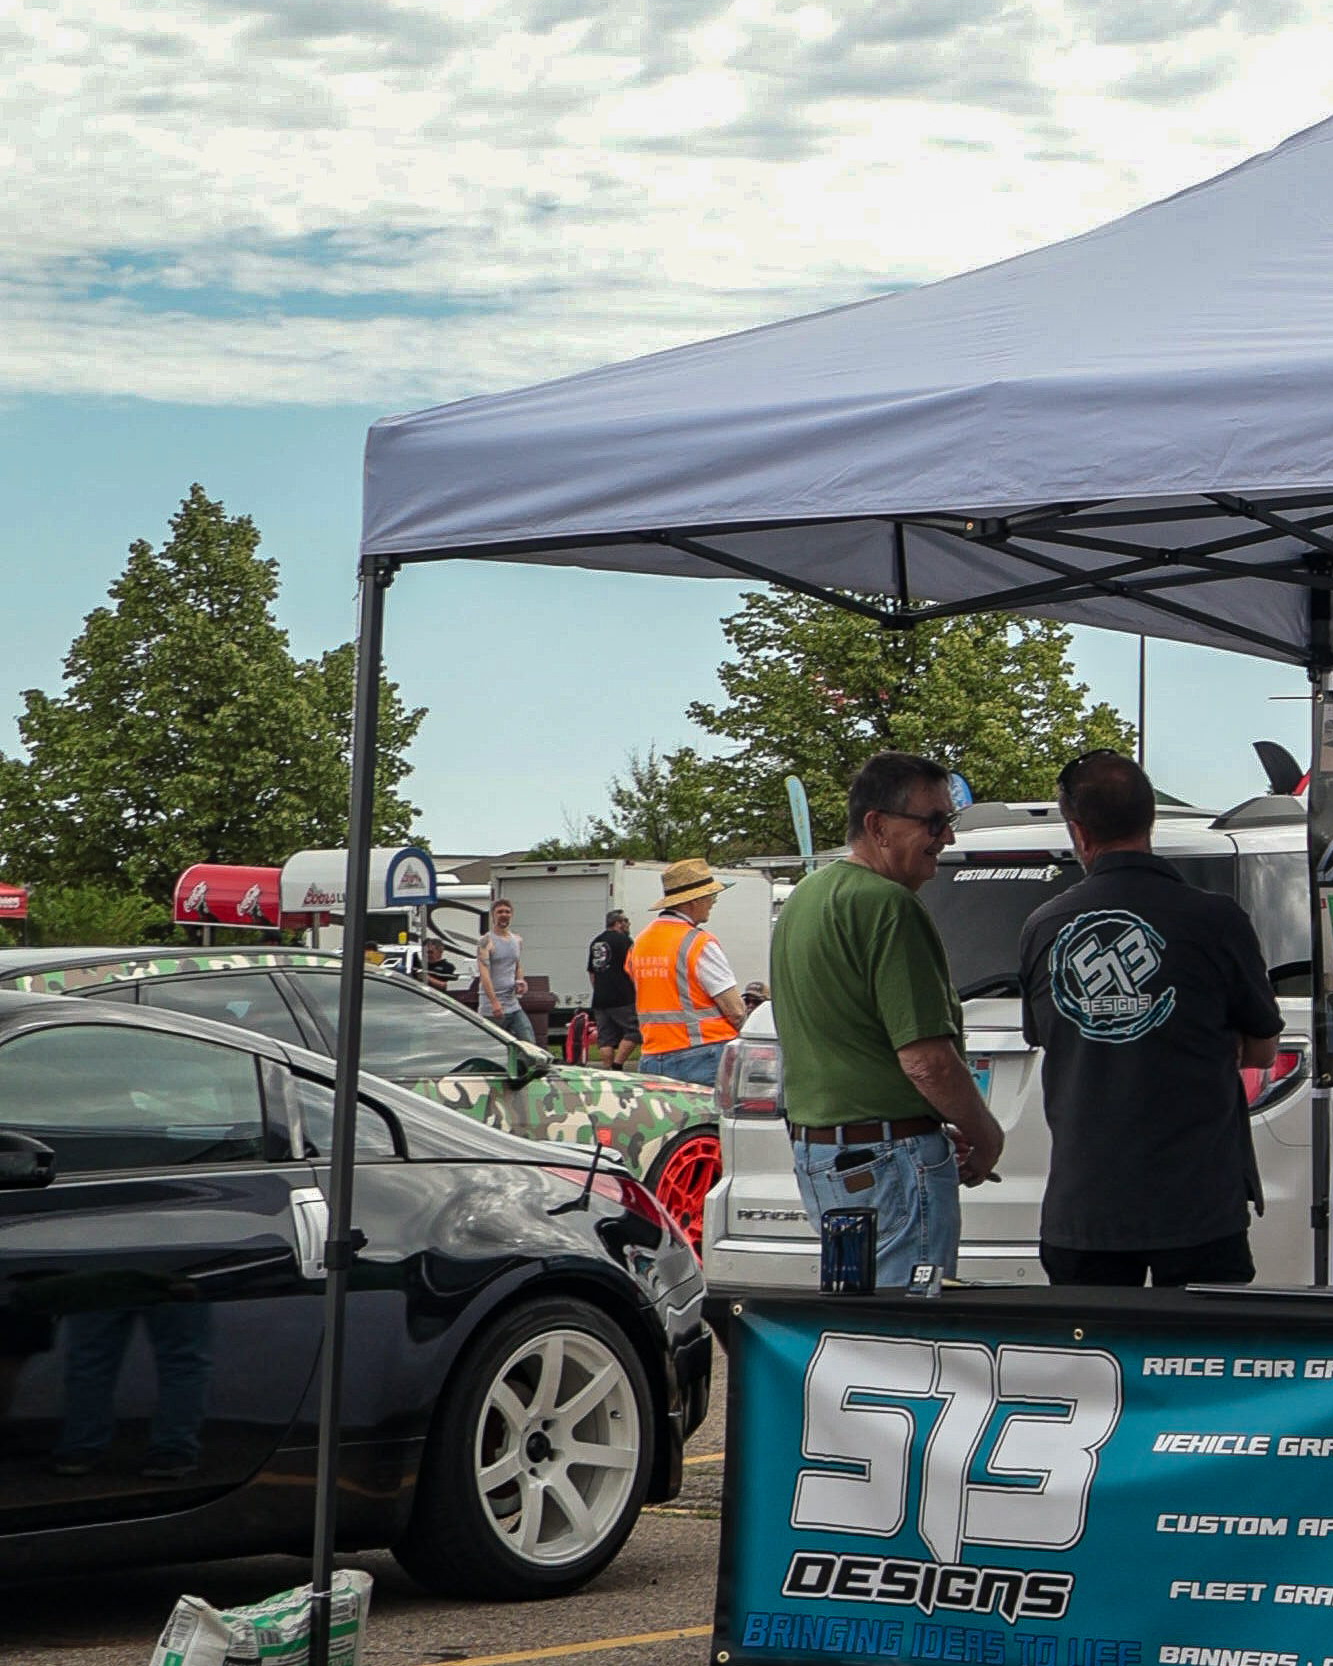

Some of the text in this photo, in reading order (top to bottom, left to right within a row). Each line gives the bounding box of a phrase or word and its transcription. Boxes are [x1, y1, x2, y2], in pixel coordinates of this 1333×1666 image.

[953, 869, 1018, 881] CUSTOM AUTO
[1071, 927, 1159, 995] 513
[1081, 995, 1151, 1014] DESIGNS
[1143, 1358, 1224, 1376] RACE
[1233, 1360, 1294, 1377] CAR
[791, 1331, 1122, 1562] 513
[1153, 1435, 1270, 1455] VEHICLE
[1157, 1515, 1288, 1535] CUSTOM
[781, 1551, 1075, 1624] DESIGNS
[1170, 1582, 1267, 1601] FLEET
[742, 1611, 904, 1656] BRINGING
[912, 1621, 1005, 1665] IDEAS
